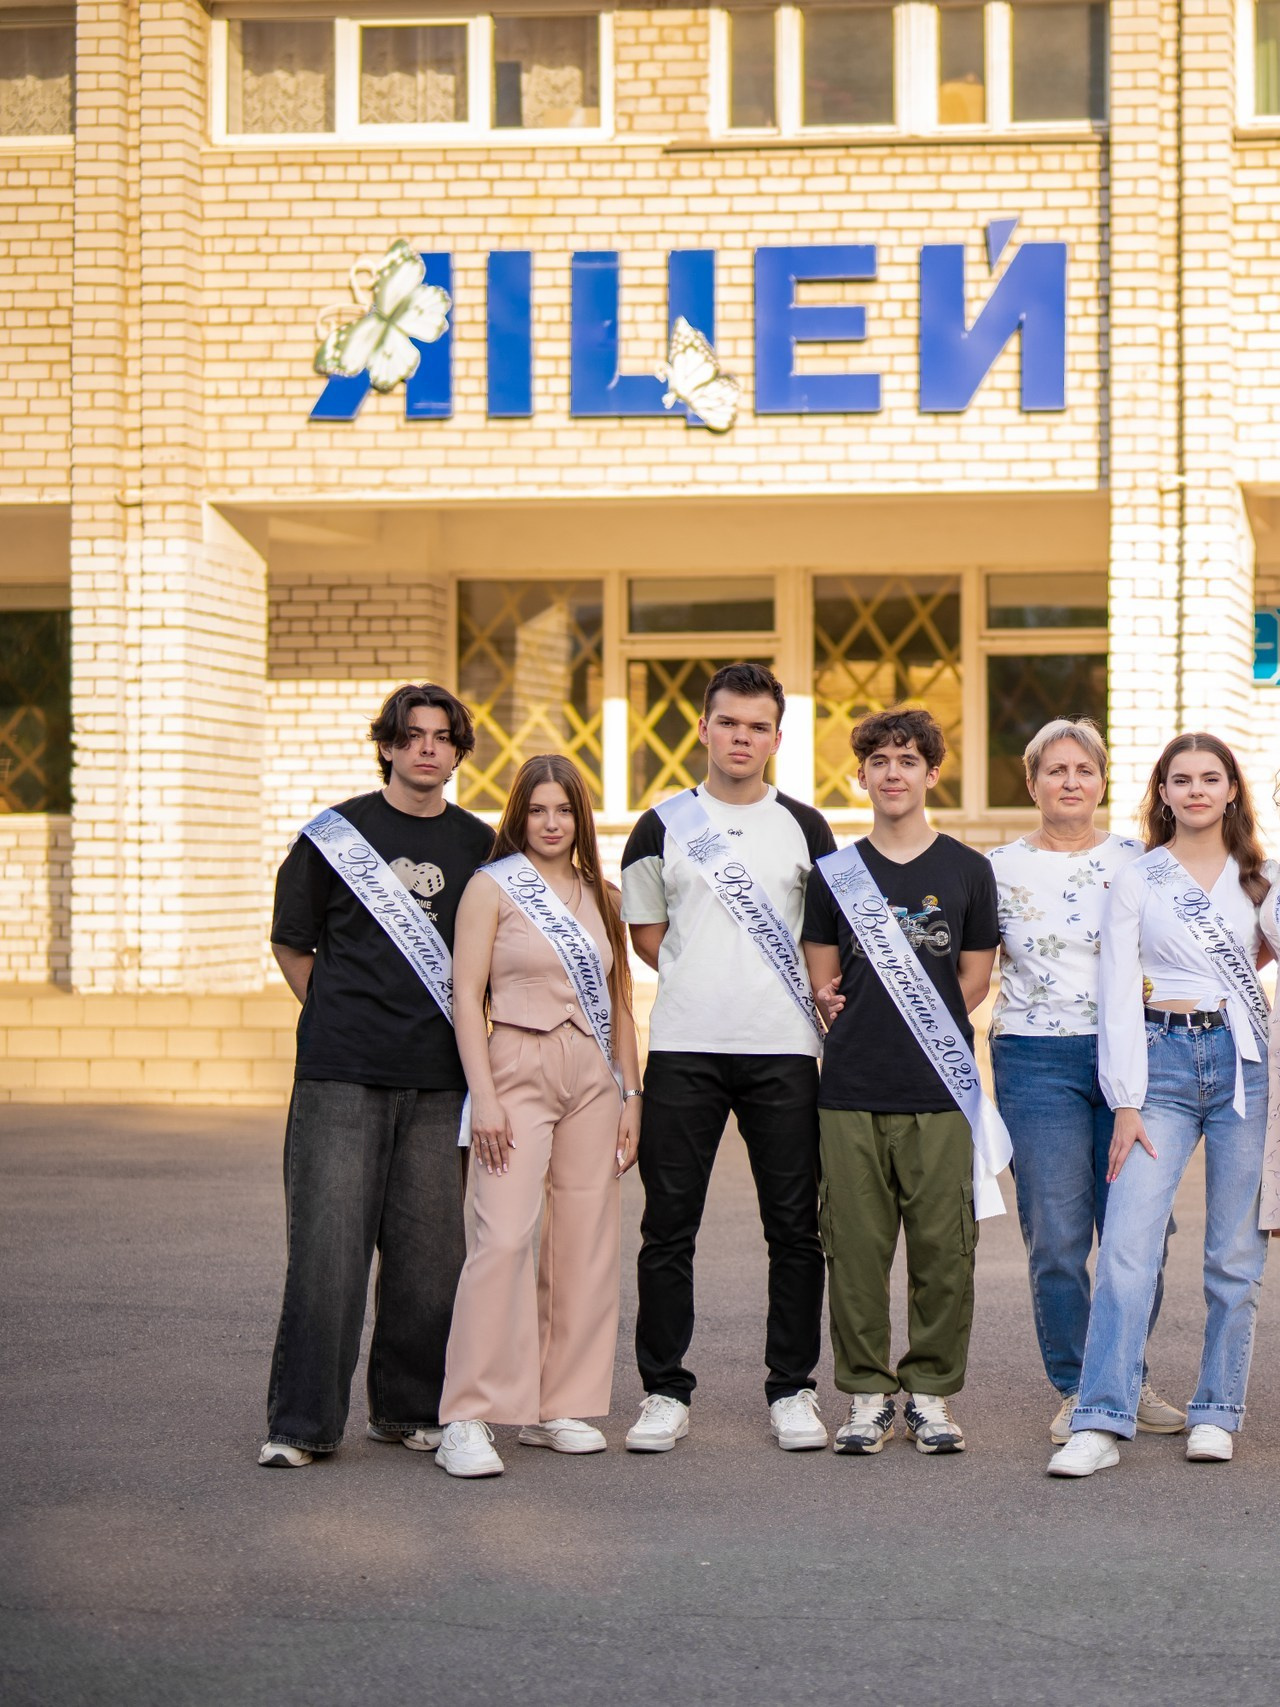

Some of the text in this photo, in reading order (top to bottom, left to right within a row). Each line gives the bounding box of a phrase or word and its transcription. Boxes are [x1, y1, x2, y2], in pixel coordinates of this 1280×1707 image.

[338, 843, 442, 975] Випускник
[355, 886, 371, 902] клас
[714, 862, 804, 991] Випускник
[730, 906, 744, 922] клас
[419, 925, 446, 960] Дмитро
[508, 867, 599, 1006] Випускниця
[864, 938, 875, 955] клас
[1174, 887, 1268, 1022] Випускниця
[853, 895, 978, 1091] Випускник 2025
[916, 983, 937, 1011] Павло
